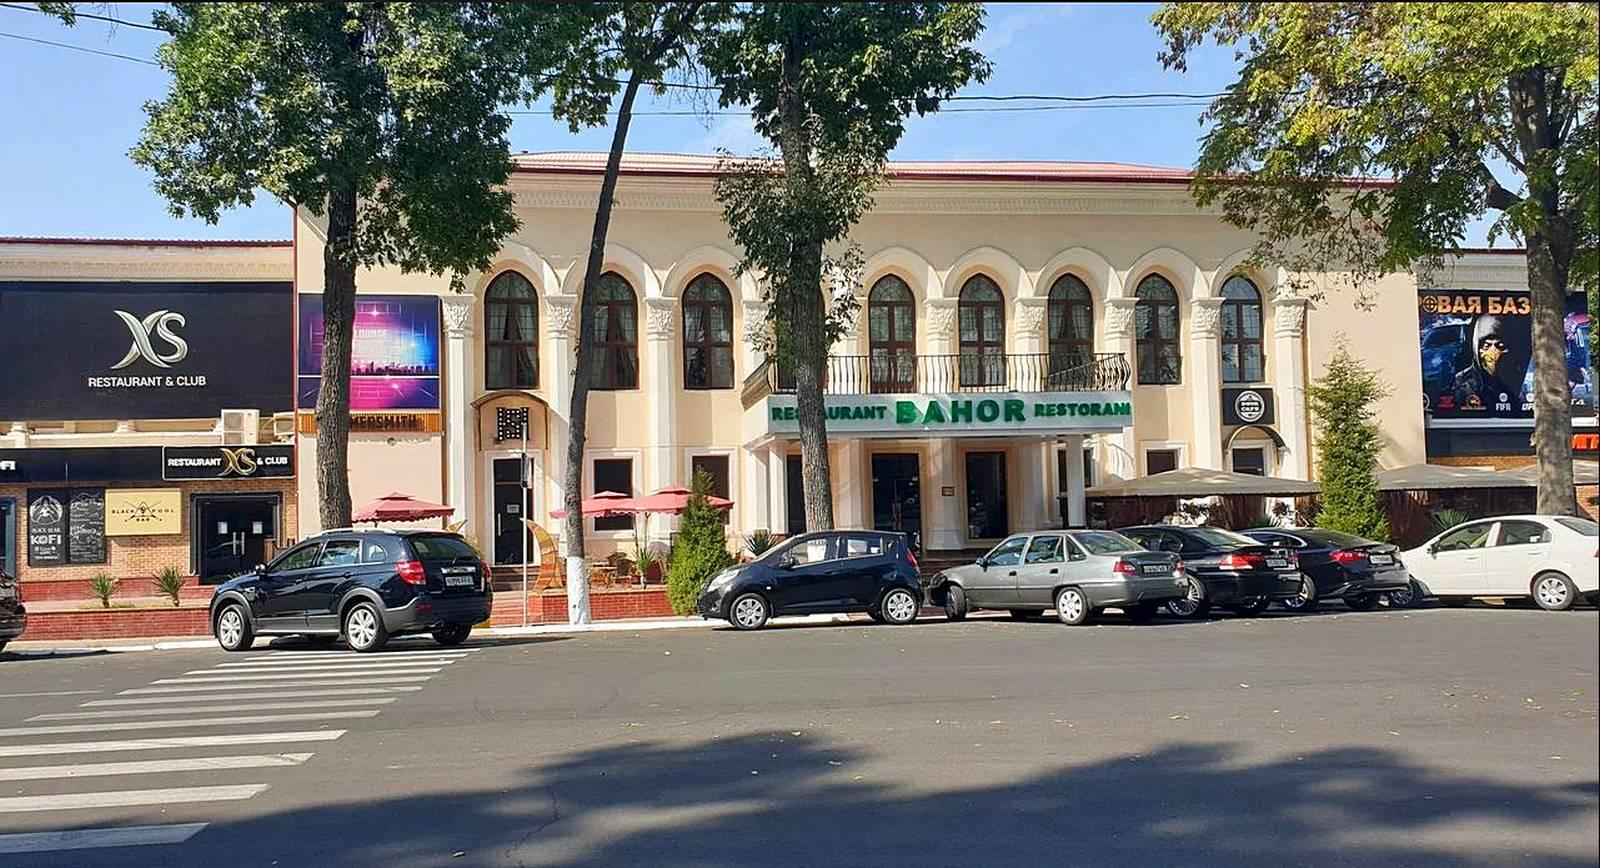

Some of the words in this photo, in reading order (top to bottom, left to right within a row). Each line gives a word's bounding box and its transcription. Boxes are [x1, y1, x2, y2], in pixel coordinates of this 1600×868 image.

[110, 309, 190, 369] XS
[88, 376, 163, 388] RESTAURANT
[165, 376, 175, 387] &
[176, 375, 207, 387] CLUB
[771, 406, 888, 421] REURANT
[896, 398, 1027, 425] BAHOR
[1033, 402, 1131, 417] RESTORANI
[167, 457, 222, 467] RESTAURANT
[216, 446, 258, 477] XS
[257, 458, 263, 466] &
[264, 456, 288, 466] CLUB
[30, 534, 62, 545] KOFI
